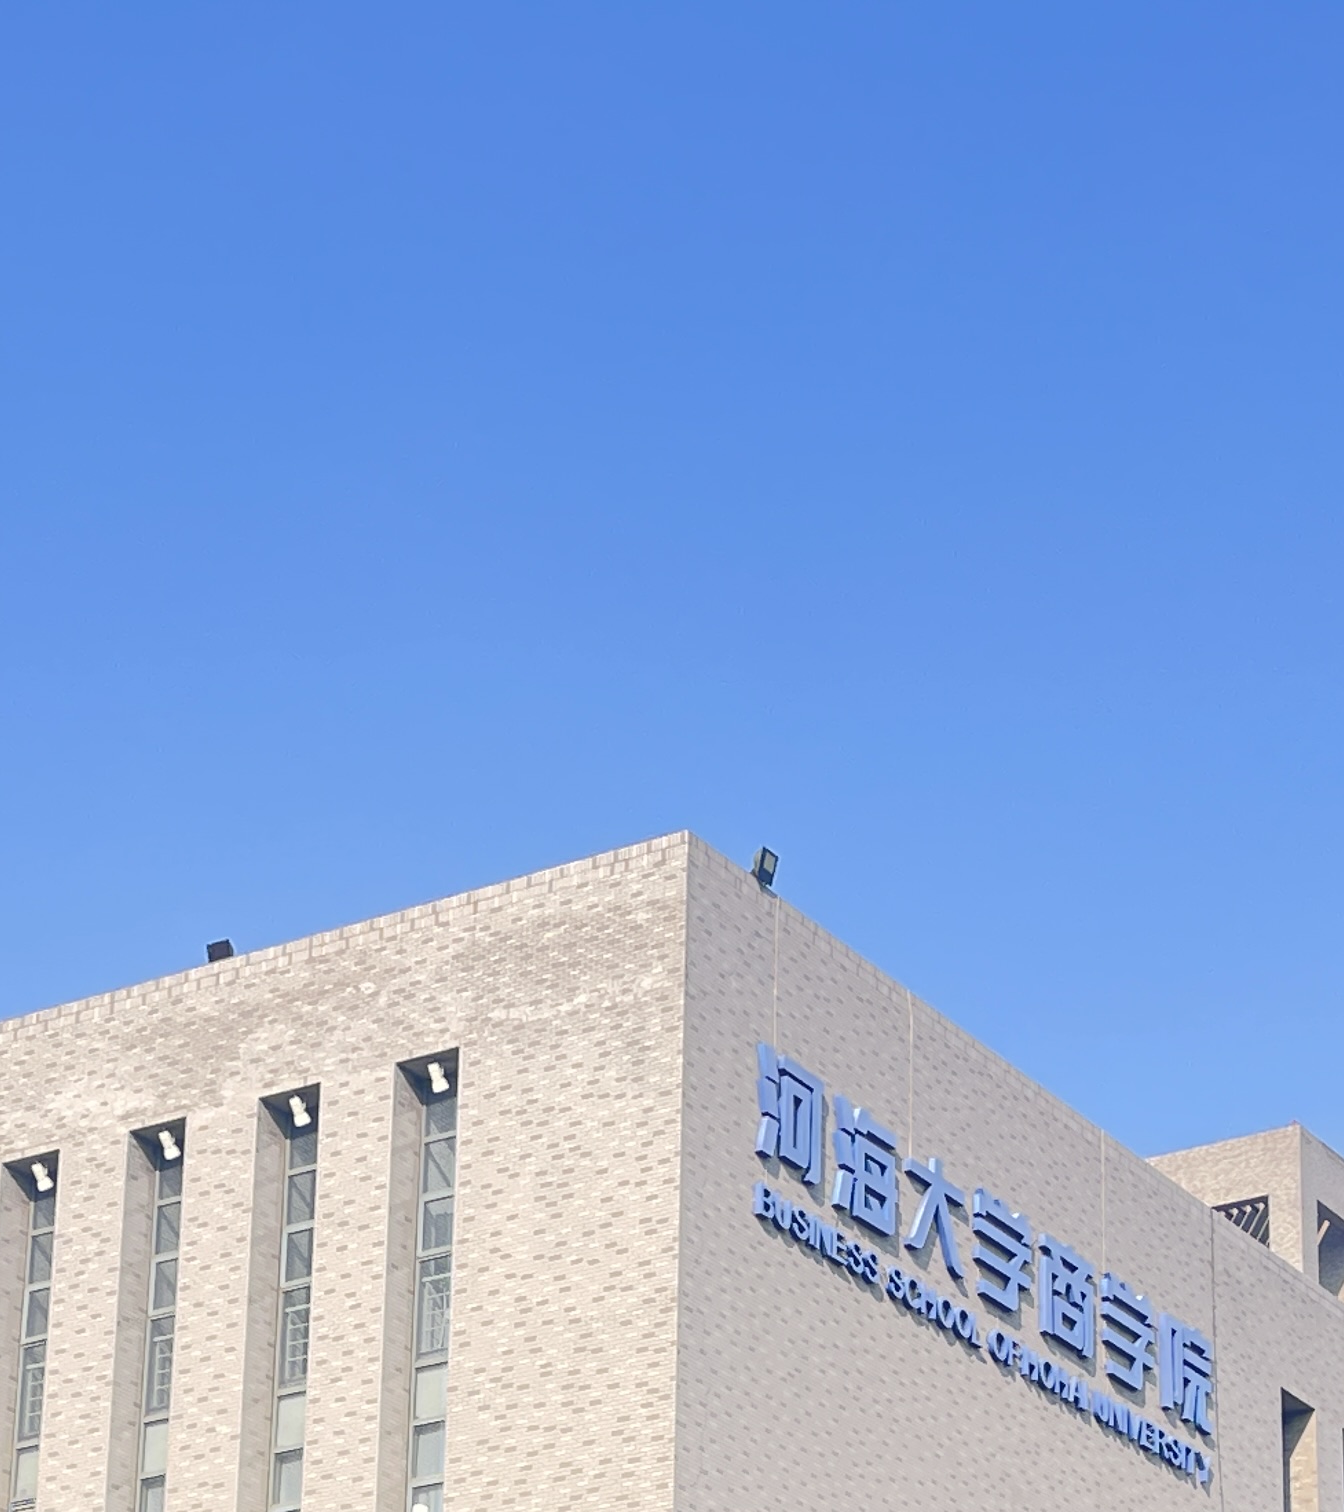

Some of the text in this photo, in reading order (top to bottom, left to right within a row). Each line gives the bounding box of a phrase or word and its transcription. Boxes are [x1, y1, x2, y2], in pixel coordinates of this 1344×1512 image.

[753, 1180, 881, 1285] BUSINESS
[886, 1264, 983, 1350] SCHOOL
[986, 1327, 1023, 1368] OF
[1091, 1388, 1212, 1484] UNIVERSITY
[755, 1040, 1213, 1437] 河海大学商学院
